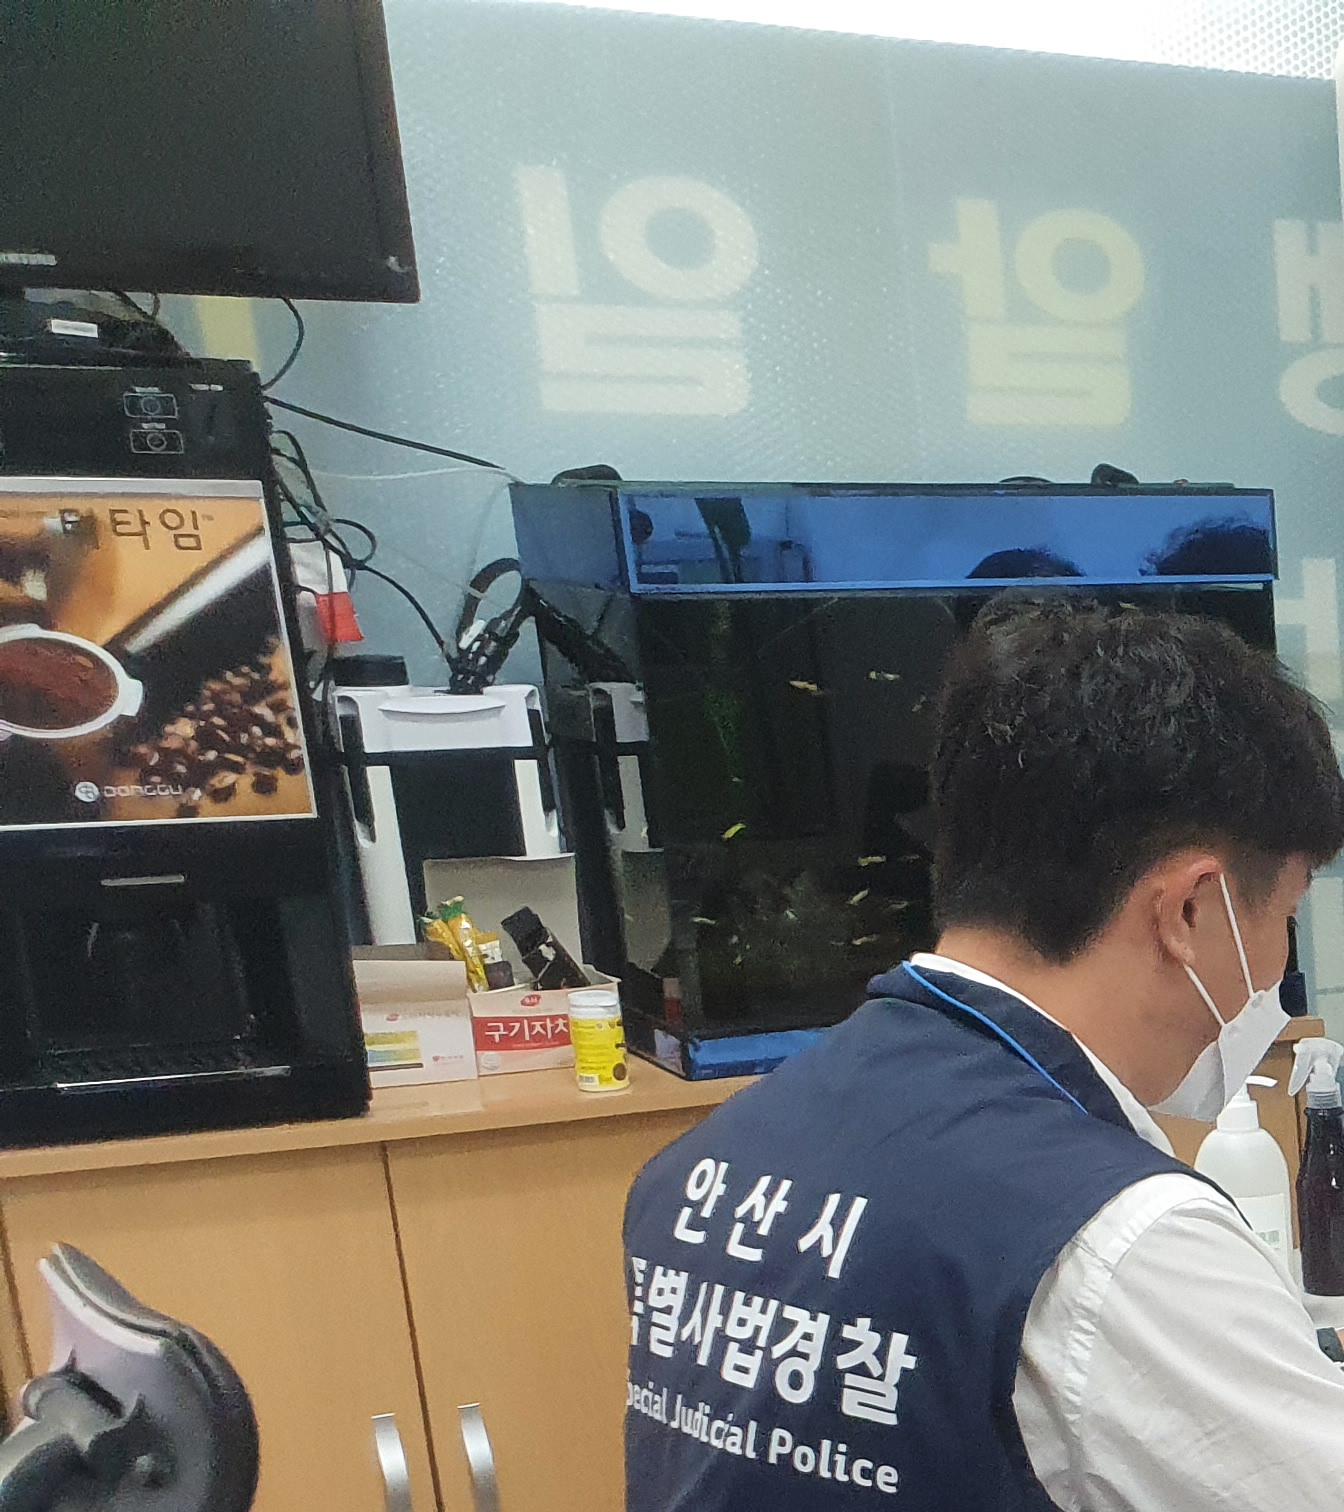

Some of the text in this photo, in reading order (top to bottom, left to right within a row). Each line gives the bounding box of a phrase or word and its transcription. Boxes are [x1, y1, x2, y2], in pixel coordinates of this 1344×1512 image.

[626, 1371, 899, 1494] pecial Judicial Police
